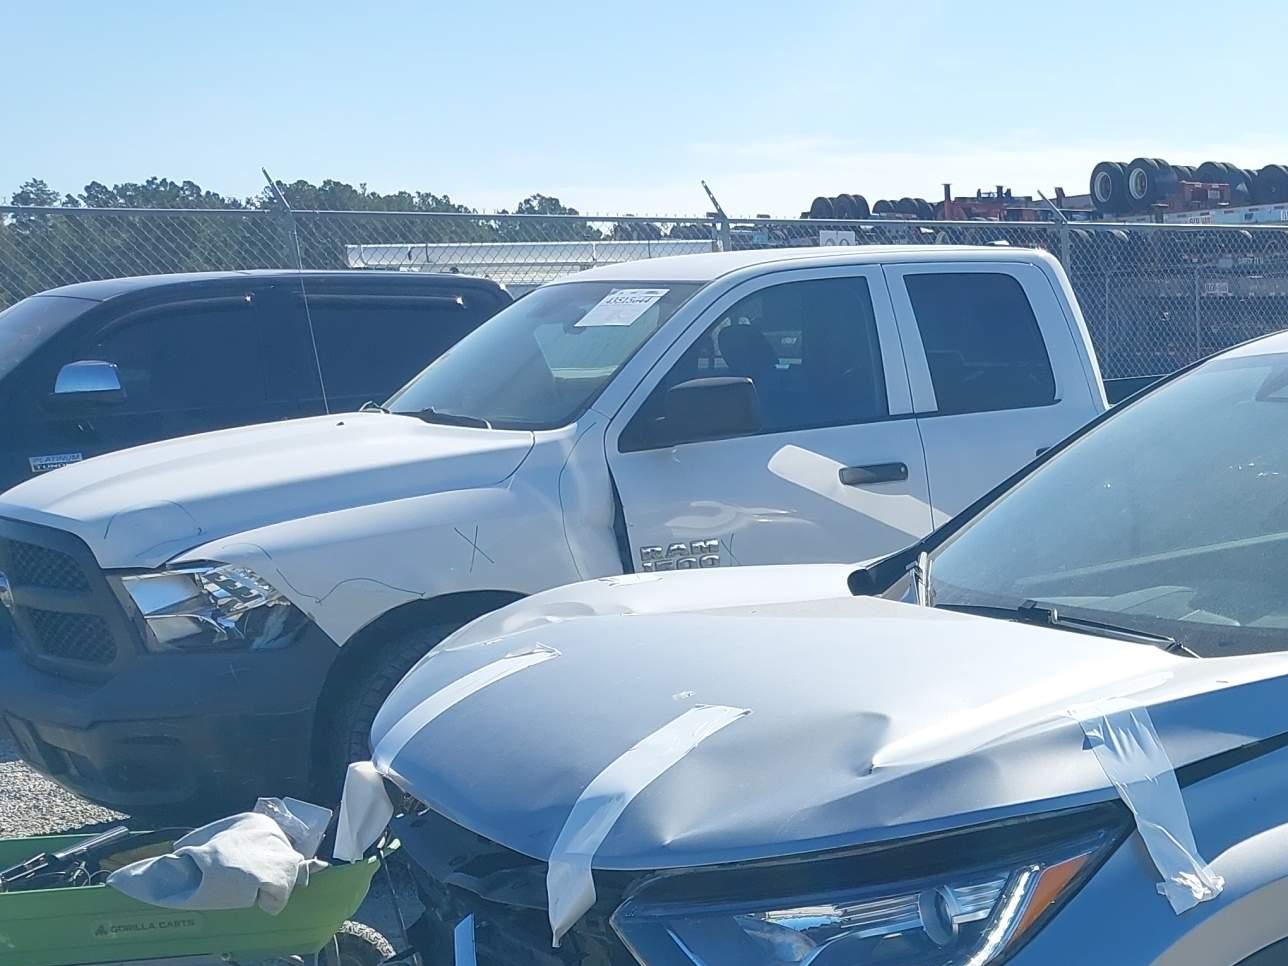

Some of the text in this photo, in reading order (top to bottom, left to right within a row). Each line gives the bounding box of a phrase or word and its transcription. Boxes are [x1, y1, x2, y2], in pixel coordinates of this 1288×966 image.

[640, 538, 719, 561] RAM
[110, 918, 196, 934] GORILLA CARTS
